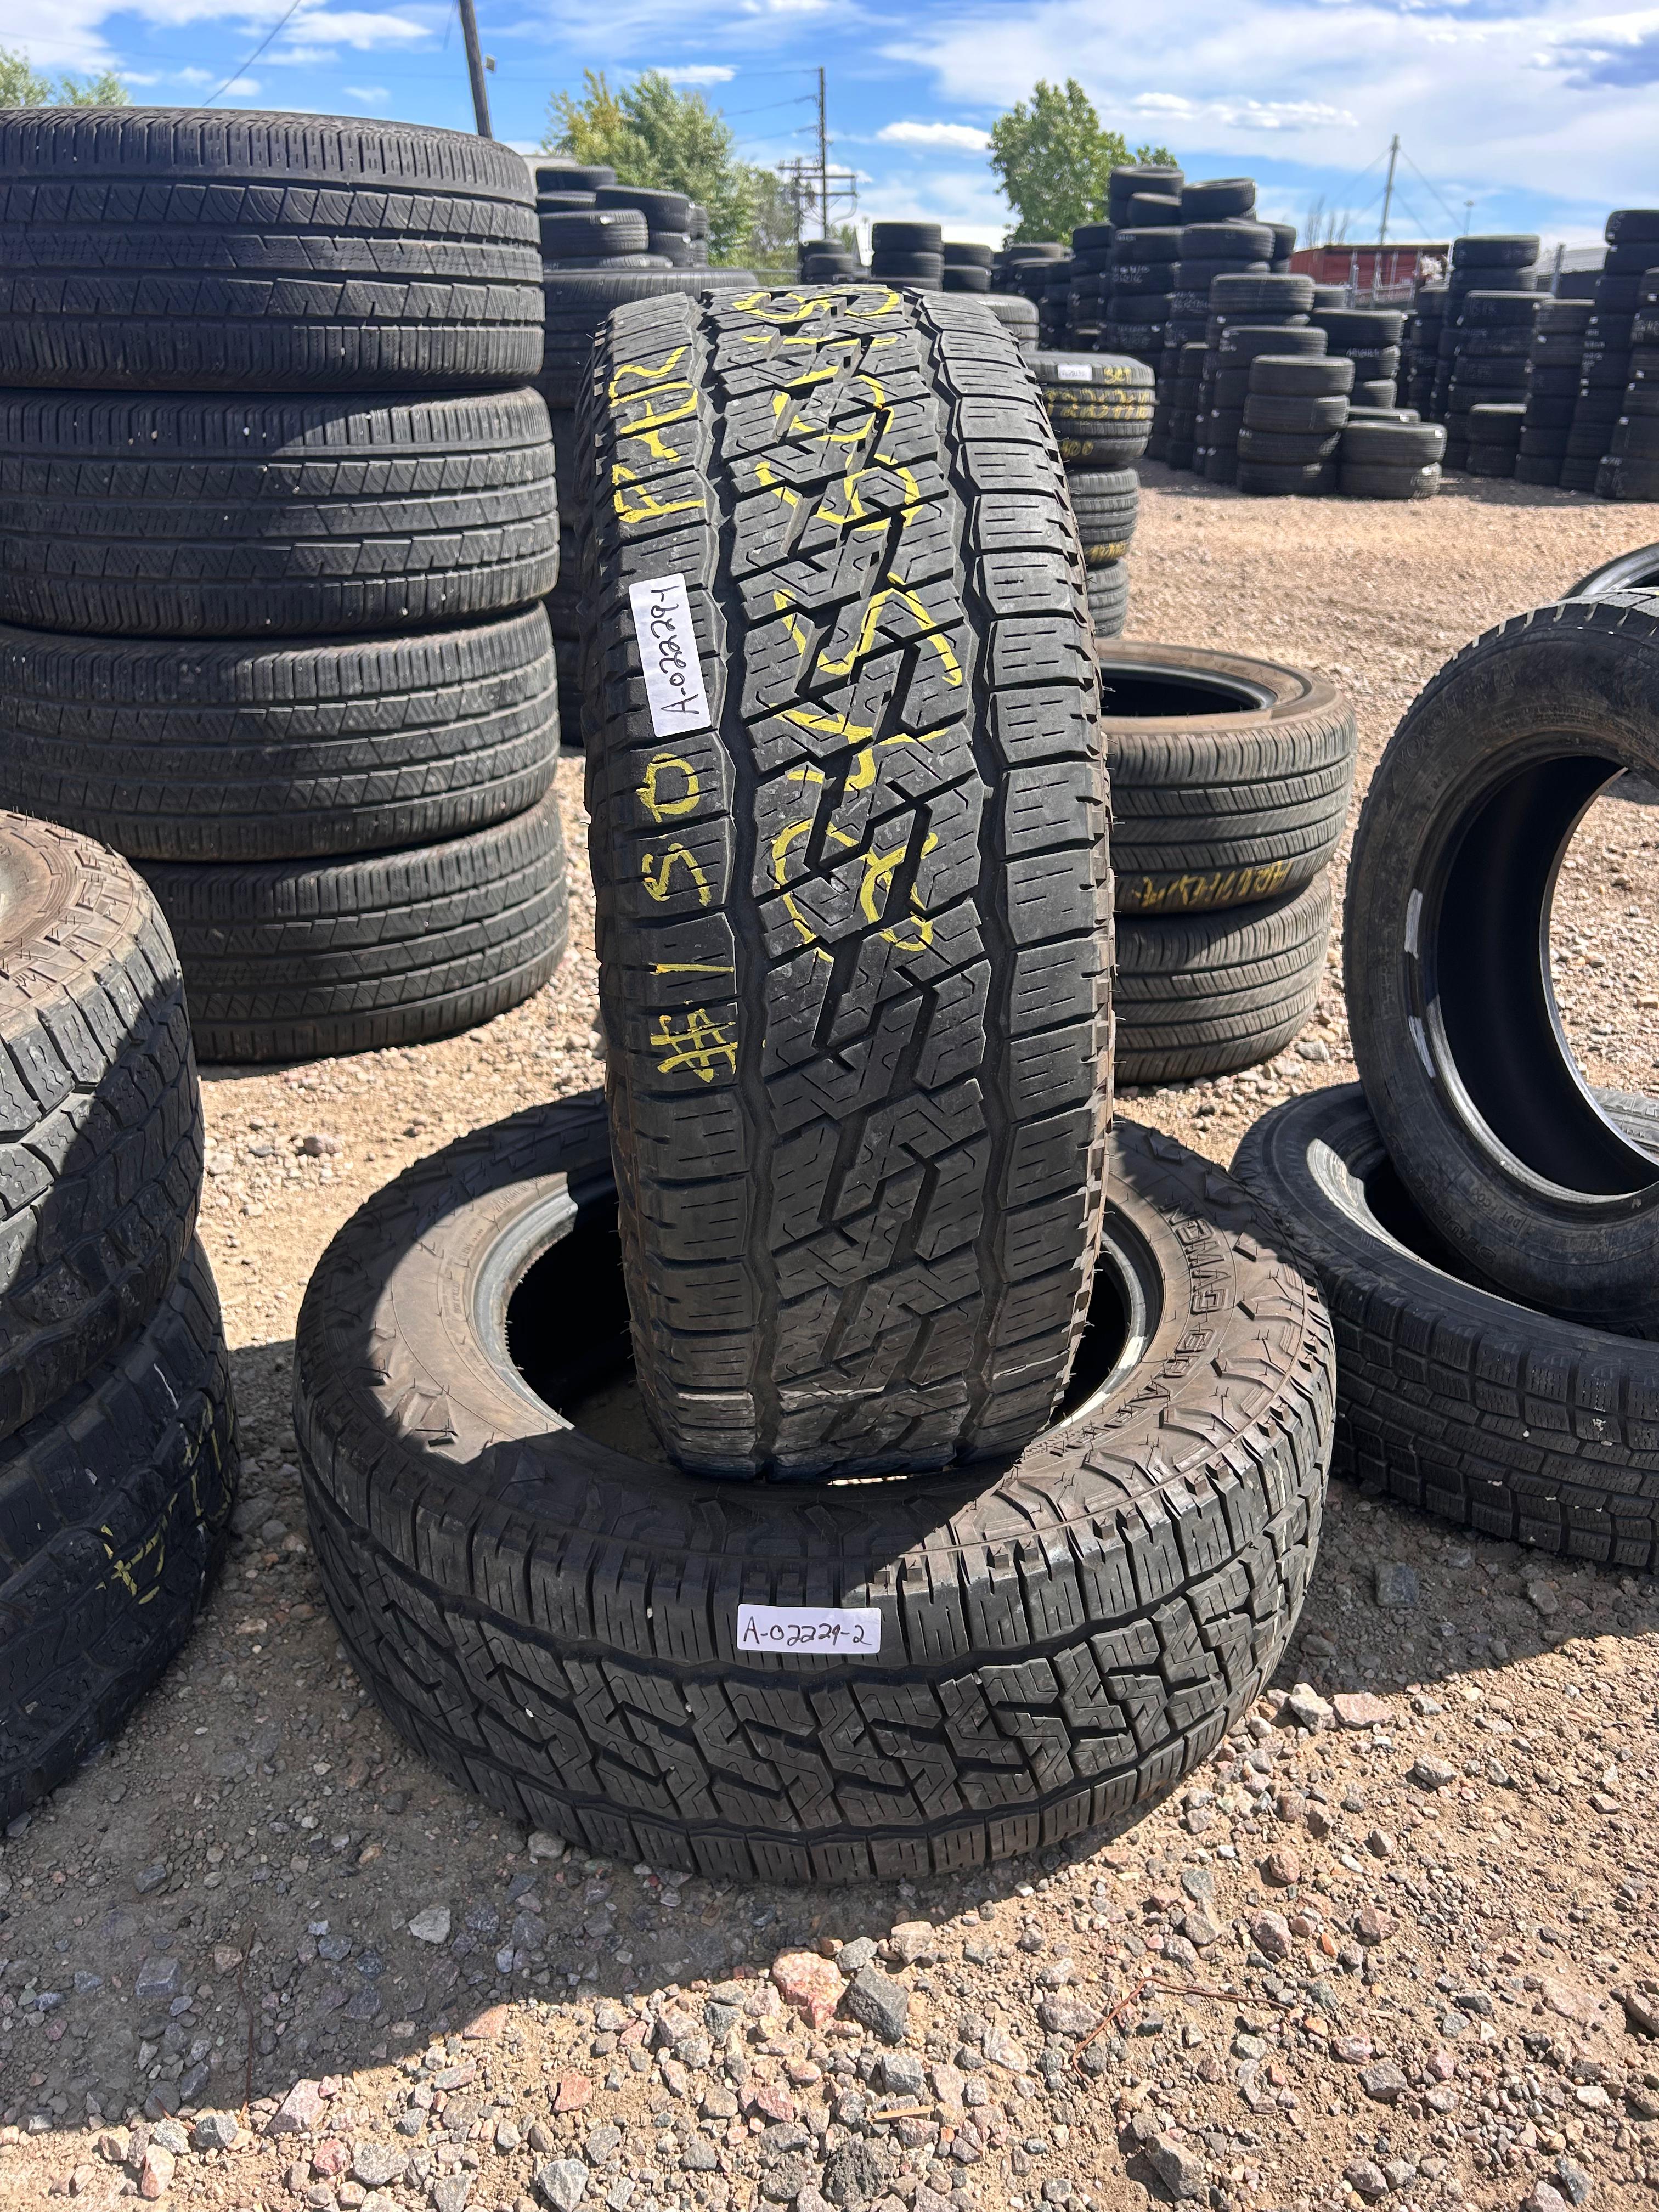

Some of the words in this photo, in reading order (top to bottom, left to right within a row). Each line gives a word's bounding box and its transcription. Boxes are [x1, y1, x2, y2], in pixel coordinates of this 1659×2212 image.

[651, 585, 699, 715] A-02229-1
[1158, 1197, 1232, 1315] NOMAD
[1500, 1211, 1522, 1229] DOT
[743, 1616, 873, 1646] A-02229-2
